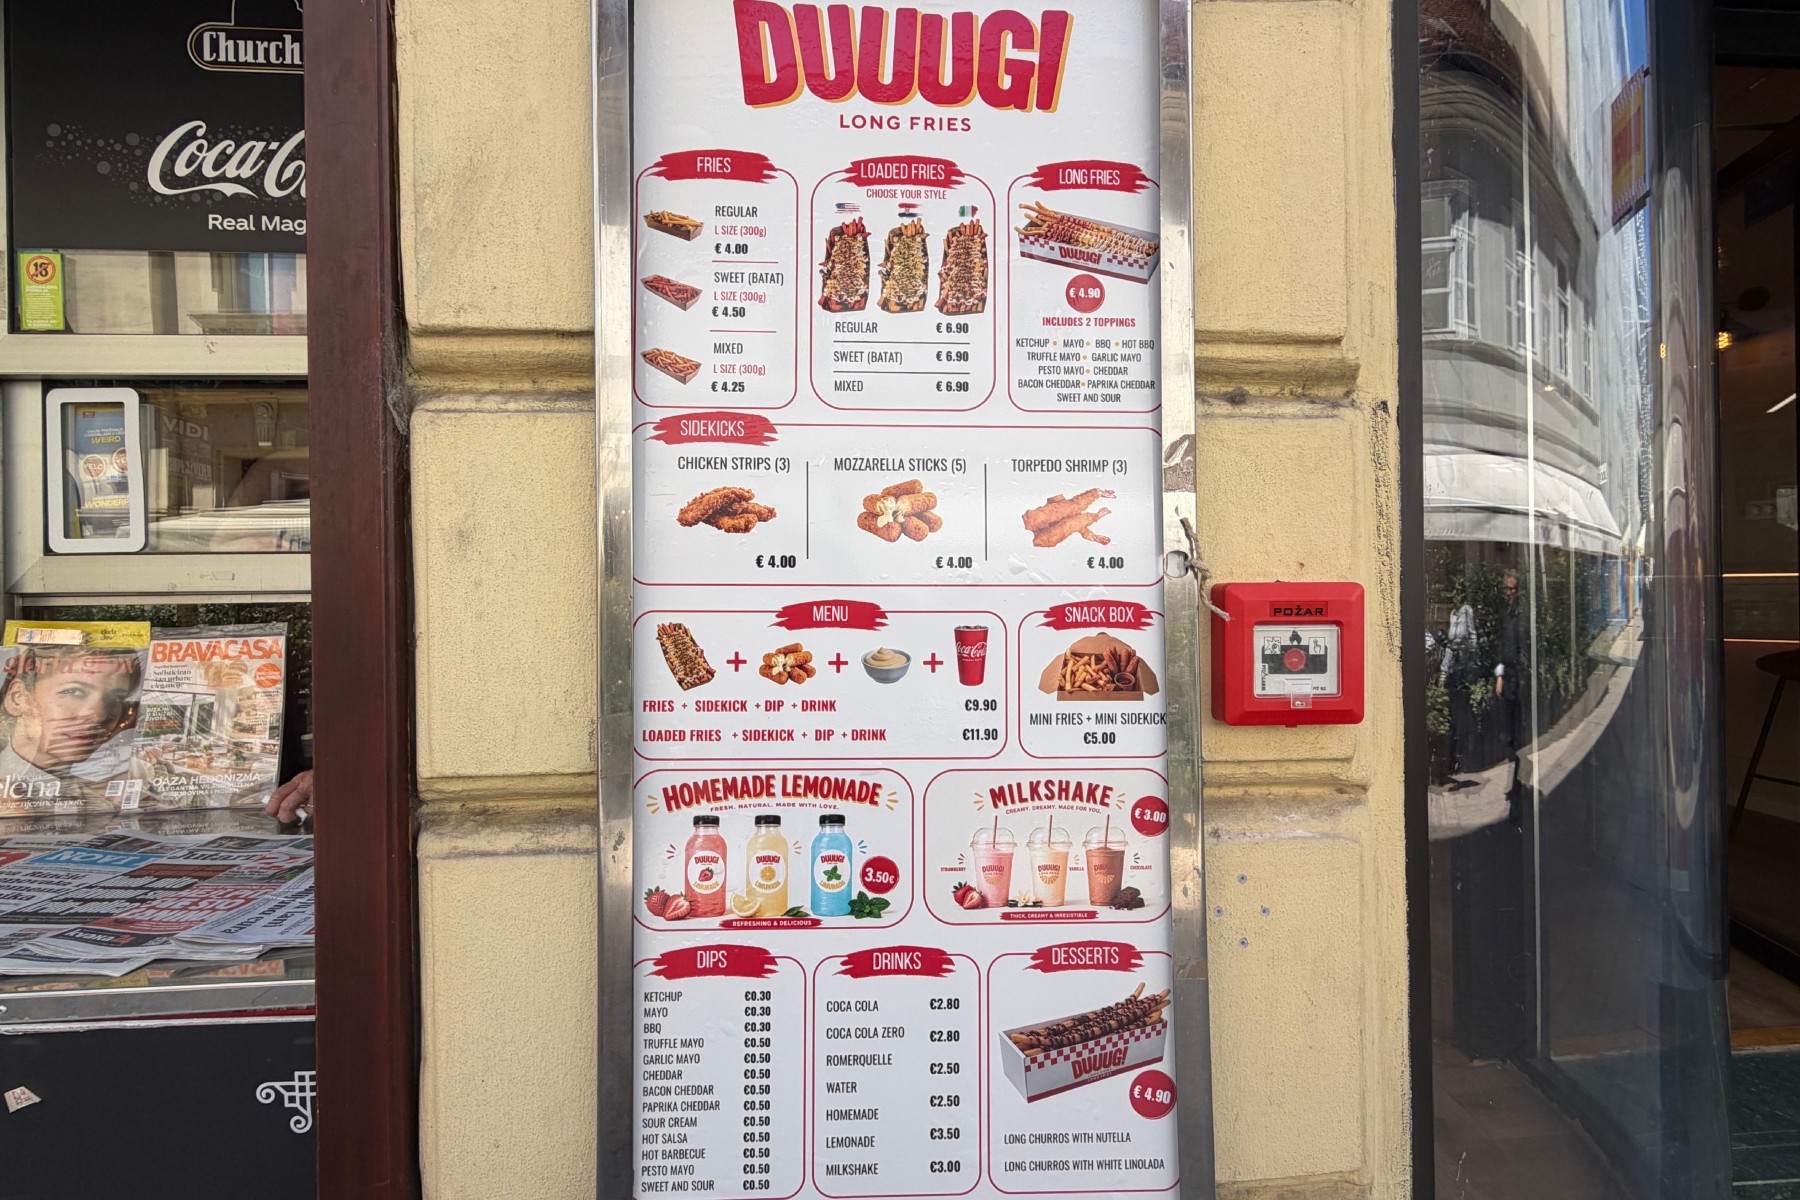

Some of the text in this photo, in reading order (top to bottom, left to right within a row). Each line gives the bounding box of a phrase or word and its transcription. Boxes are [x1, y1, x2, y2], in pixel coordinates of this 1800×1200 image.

[203, 31, 303, 65] Church
[839, 114, 972, 132] LONG FRIES
[697, 157, 731, 172] FRIES
[860, 163, 945, 180] LOADED FRIES
[1059, 169, 1120, 185] LONG FRIES
[866, 188, 947, 199] CHOOSE YOUR STYLE
[715, 206, 757, 217] REGULAR
[208, 214, 255, 231] Real
[715, 225, 767, 237] L SIZE (300g)
[714, 243, 748, 254] € 4.00
[33, 262, 49, 277] 18
[714, 272, 784, 286] SWEET (BATAT)
[1069, 288, 1100, 298] € 4.90
[712, 306, 745, 317] € 4.50
[835, 322, 878, 333] REGULAR
[936, 322, 969, 334] € 6.90
[1042, 317, 1135, 327] INCLUDES 2 TOPPINGS
[714, 343, 743, 354] MIXED
[1016, 338, 1154, 350] KETCHUP MAYO BBQ HOT BBQ
[1027, 352, 1141, 362] TRUFFLE MAYO GARLIC MAYO
[1057, 393, 1121, 402] SWEET AND SOUR
[680, 420, 744, 437] SIDEKICKS
[678, 456, 790, 473] CHICKEN STRIPS (3)
[834, 458, 966, 474] MOZZARELLA STICKS (5)
[1012, 459, 1127, 475] TORPEDO SHRIMP (3)
[756, 555, 796, 568] € 4.00
[1087, 557, 1124, 569] € 4.00
[813, 606, 848, 621] MENU
[1065, 607, 1134, 622] SNACK BOX
[1273, 605, 1324, 616] POŽAR
[151, 638, 283, 663] BRAVACASA
[643, 700, 674, 712] FRIES
[695, 700, 748, 712] SIDEKICK
[765, 700, 784, 712] DIP
[801, 700, 836, 712] DRINK
[965, 699, 997, 711] €9.90
[1030, 713, 1052, 725] MINI
[1056, 713, 1083, 725] FRIES
[1095, 713, 1117, 725] MINI
[1121, 713, 1167, 725] SIDEKICK
[643, 730, 686, 741] LOADED
[690, 730, 721, 741] FRIES
[742, 730, 794, 741] SIDEKICK
[815, 730, 834, 741] DIP
[851, 730, 886, 741] DRINK
[963, 729, 998, 740] €11.90
[1083, 732, 1116, 744] €5.00
[153, 776, 187, 786] OAZA
[662, 774, 882, 812] HOMEMADE LEMONADE
[989, 780, 1114, 809] MILKSHAKE
[1135, 808, 1166, 823] € 3.00
[864, 867, 895, 884] 3.50€
[697, 951, 727, 968] DIPS
[873, 952, 921, 970] DRINKS
[1052, 947, 1119, 965] DESSERTS
[644, 992, 682, 1002] KETCHUP
[745, 991, 771, 1001] €0.30
[826, 1000, 879, 1012] COCA COLA
[930, 998, 960, 1010] €2.80
[643, 1038, 704, 1049] TRUFFLE MAYO
[744, 1038, 771, 1048] €0.50
[826, 1054, 892, 1067] ROMERQUELLE
[930, 1063, 960, 1074] €2.50
[826, 1082, 857, 1093] WATER
[1133, 1085, 1171, 1103] € 4.90
[826, 1109, 879, 1120] HOMEMADE
[930, 1128, 960, 1139] €3.50
[826, 1136, 875, 1148] LEMONADE
[826, 1163, 879, 1176] MILKSHAKE
[930, 1161, 960, 1172] €3.00
[1004, 1159, 1164, 1171] LONG CHURROS WITH WHITE LINOLADA
[641, 1180, 714, 1192] SWEET AND SOUR
[743, 1180, 769, 1190] €0.50
